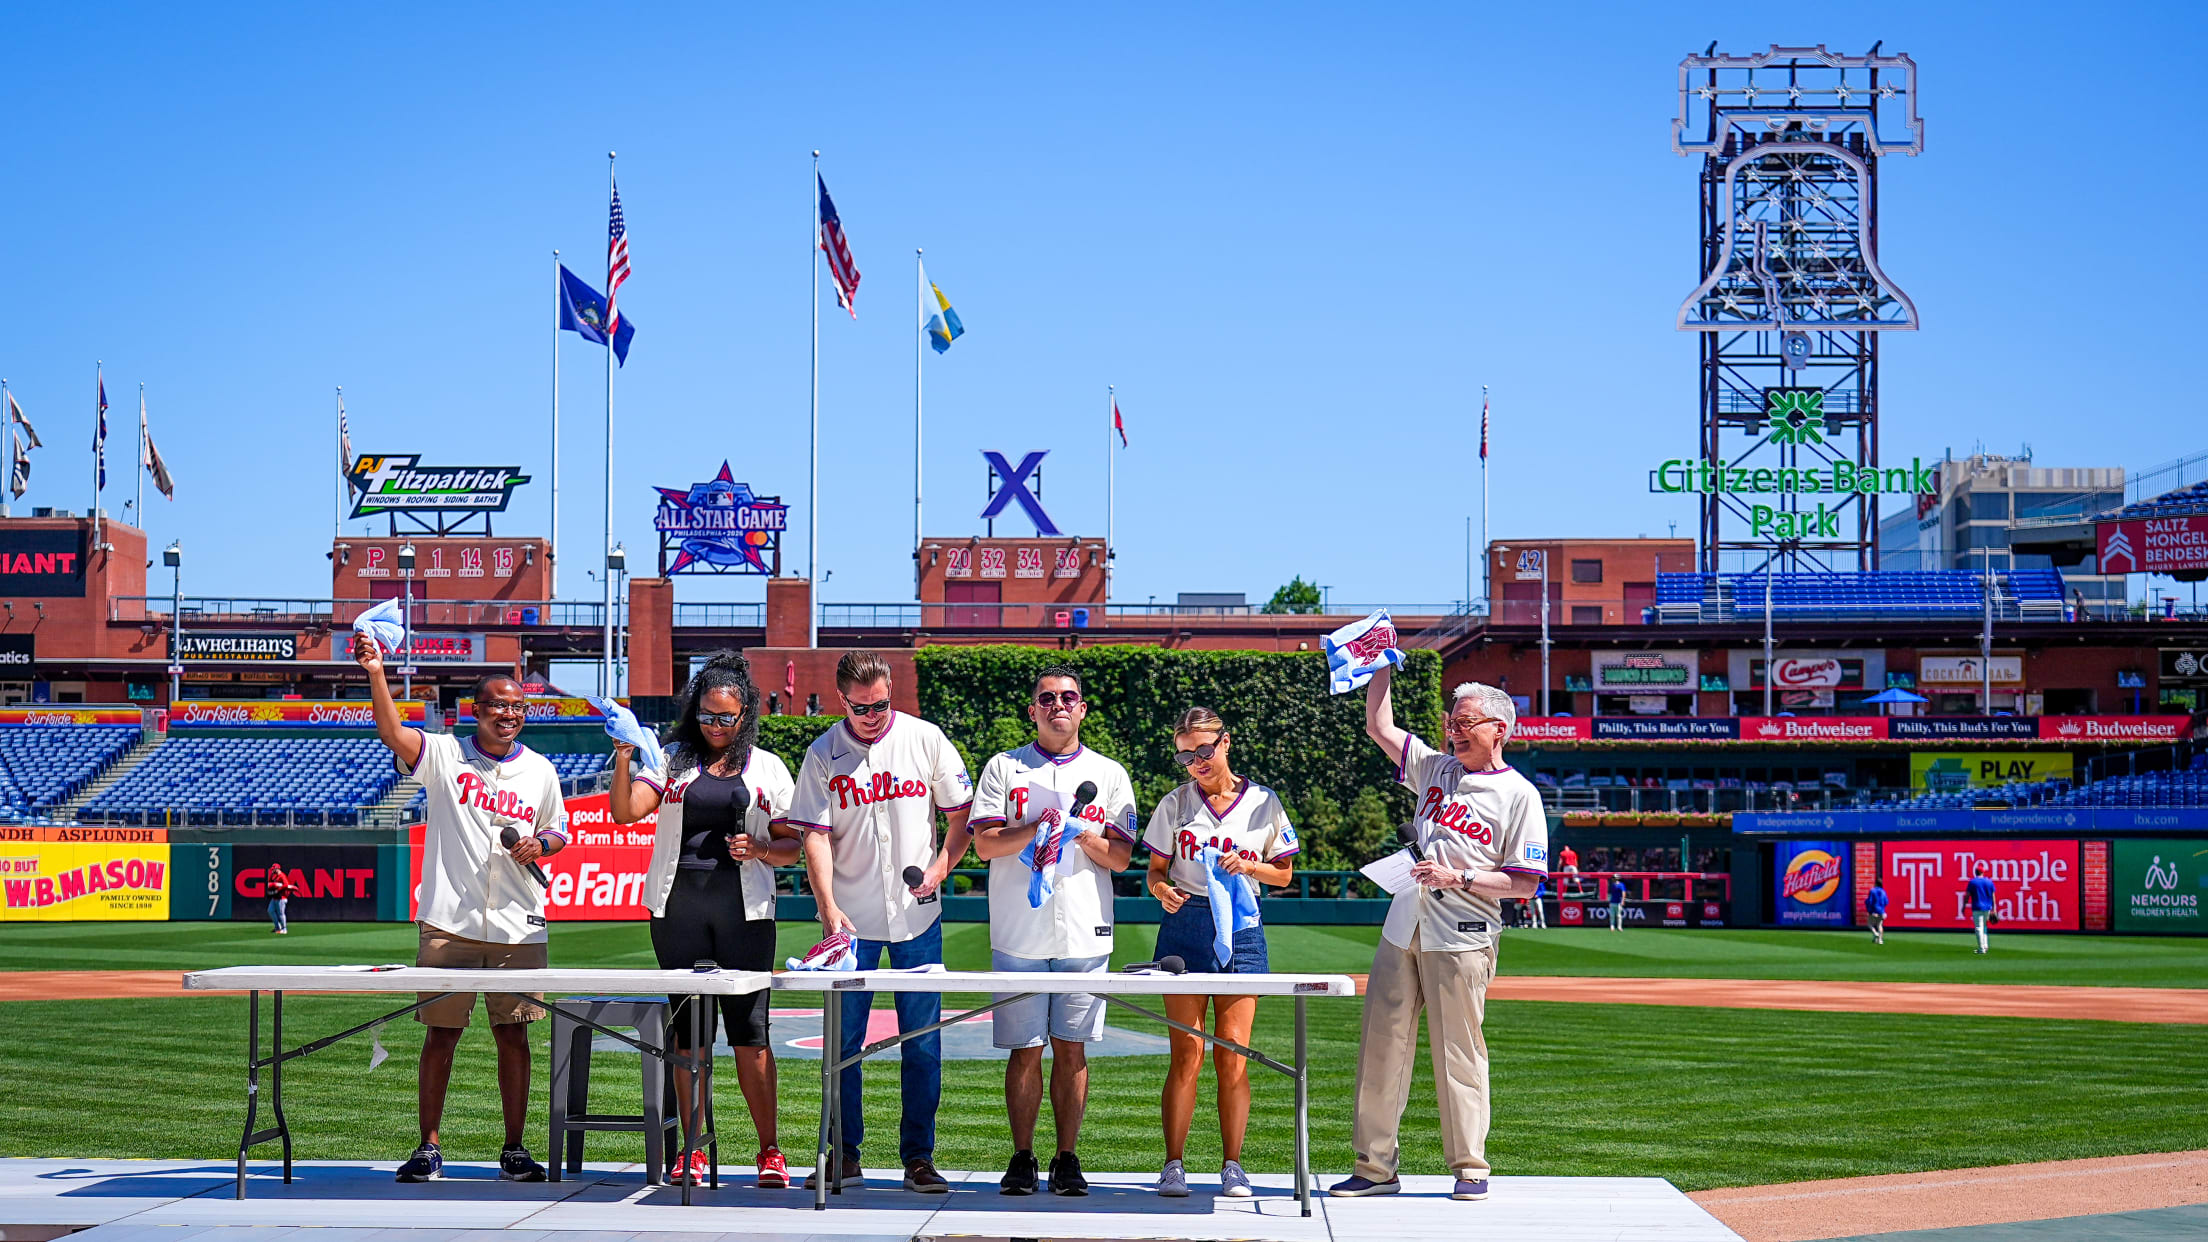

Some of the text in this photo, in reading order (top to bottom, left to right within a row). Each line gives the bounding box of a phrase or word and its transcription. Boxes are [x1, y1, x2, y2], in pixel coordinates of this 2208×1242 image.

[354, 457, 511, 493] PJ Fitzpatrick
[1657, 457, 1822, 494] Citizens
[1832, 456, 1938, 495] Bank
[656, 506, 785, 530] ALL STAR GAME
[1751, 502, 1839, 538] Park
[2145, 518, 2189, 533] SALTZ
[2145, 531, 2208, 547] MONGEL
[0, 553, 76, 574] IANT
[367, 547, 385, 568] P
[431, 548, 442, 569] 1
[461, 548, 482, 569] 14
[493, 548, 513, 569] 15
[947, 548, 972, 570] 20
[980, 548, 1005, 569] 32
[1018, 548, 1042, 569] 34
[1055, 548, 1080, 569] 36
[1516, 550, 1541, 571] 42
[2145, 562, 2173, 570] INJURY
[1925, 669, 1978, 680] COCKTAIL
[24, 711, 71, 727] Surfside
[184, 703, 249, 724] Surfside
[308, 703, 373, 724] Surfside
[1598, 722, 1730, 735] Philly, This Bud's For You
[1784, 721, 1872, 737] Budweiser
[1897, 722, 2031, 735] Philly, This Bud's For You
[2085, 721, 2175, 736] Budweiser
[1981, 760, 2035, 780] PLAY
[829, 771, 927, 809] Phillies
[572, 808, 603, 826] good
[1419, 786, 1493, 845] Phillies
[1757, 816, 1822, 828] Independence
[1897, 817, 1937, 827] ibx.com
[1991, 813, 2062, 825] Independence
[2134, 814, 2179, 825] ibx.com
[57, 830, 154, 842] ASPLUNDH
[577, 830, 611, 845] Farm
[613, 830, 624, 845] is
[14, 859, 38, 872] BUT
[1954, 851, 2067, 890] Temple
[234, 868, 374, 898] GANT
[1785, 857, 1841, 896] Hatfield
[1955, 891, 2061, 922] Halth
[2131, 894, 2198, 906] NEMOURS
[2131, 907, 2198, 917] CHILDREN'S HEALTH
